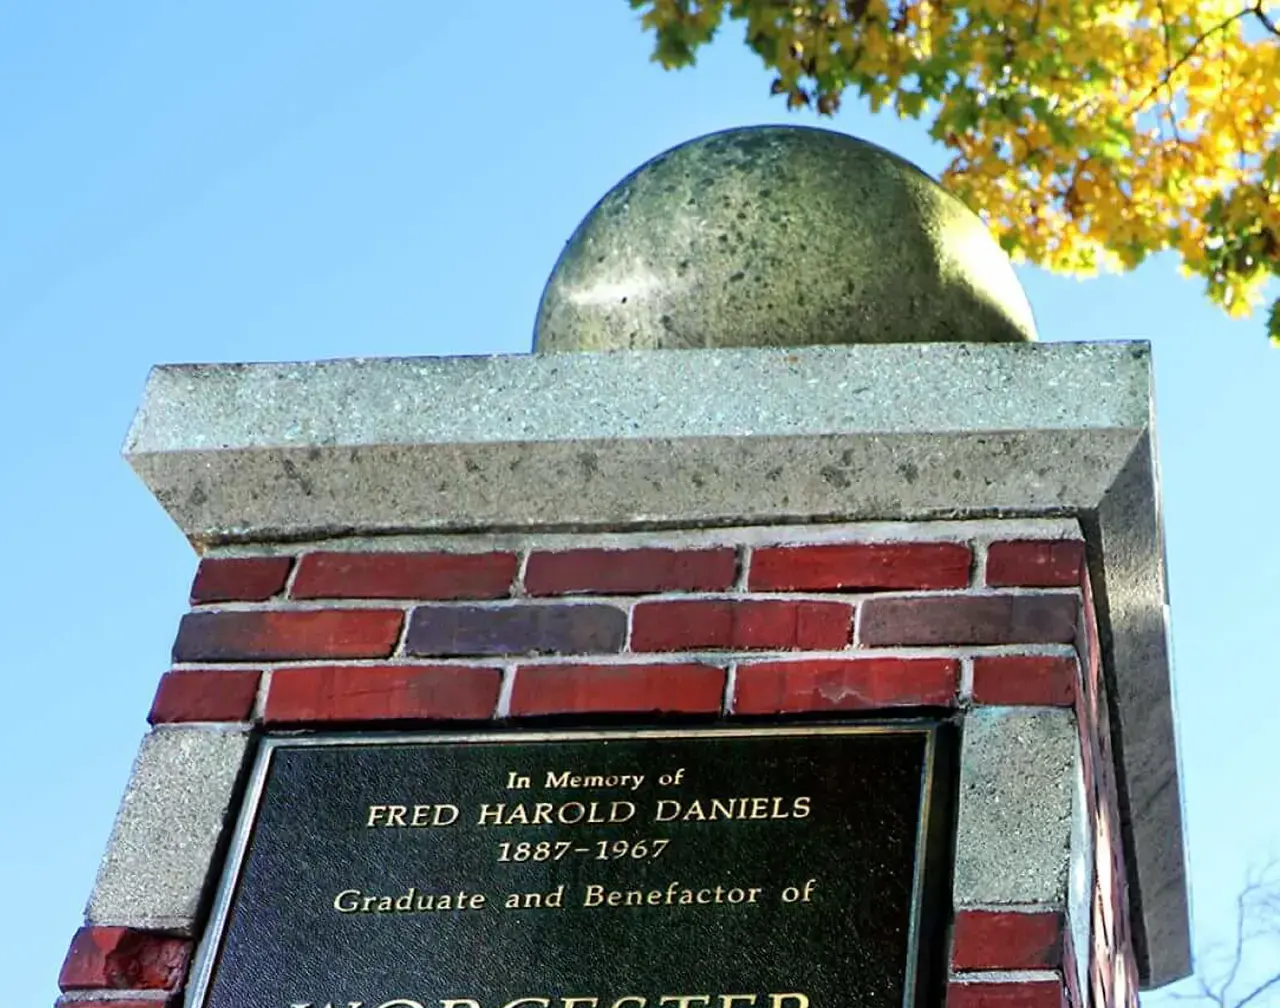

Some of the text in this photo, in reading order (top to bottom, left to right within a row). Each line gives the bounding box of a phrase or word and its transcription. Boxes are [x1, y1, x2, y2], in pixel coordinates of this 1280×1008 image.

[506, 767, 685, 791] In Memory of
[367, 796, 811, 828] FRED HAROLD DANIELS
[334, 879, 817, 914] Graduate and Benefactor of
